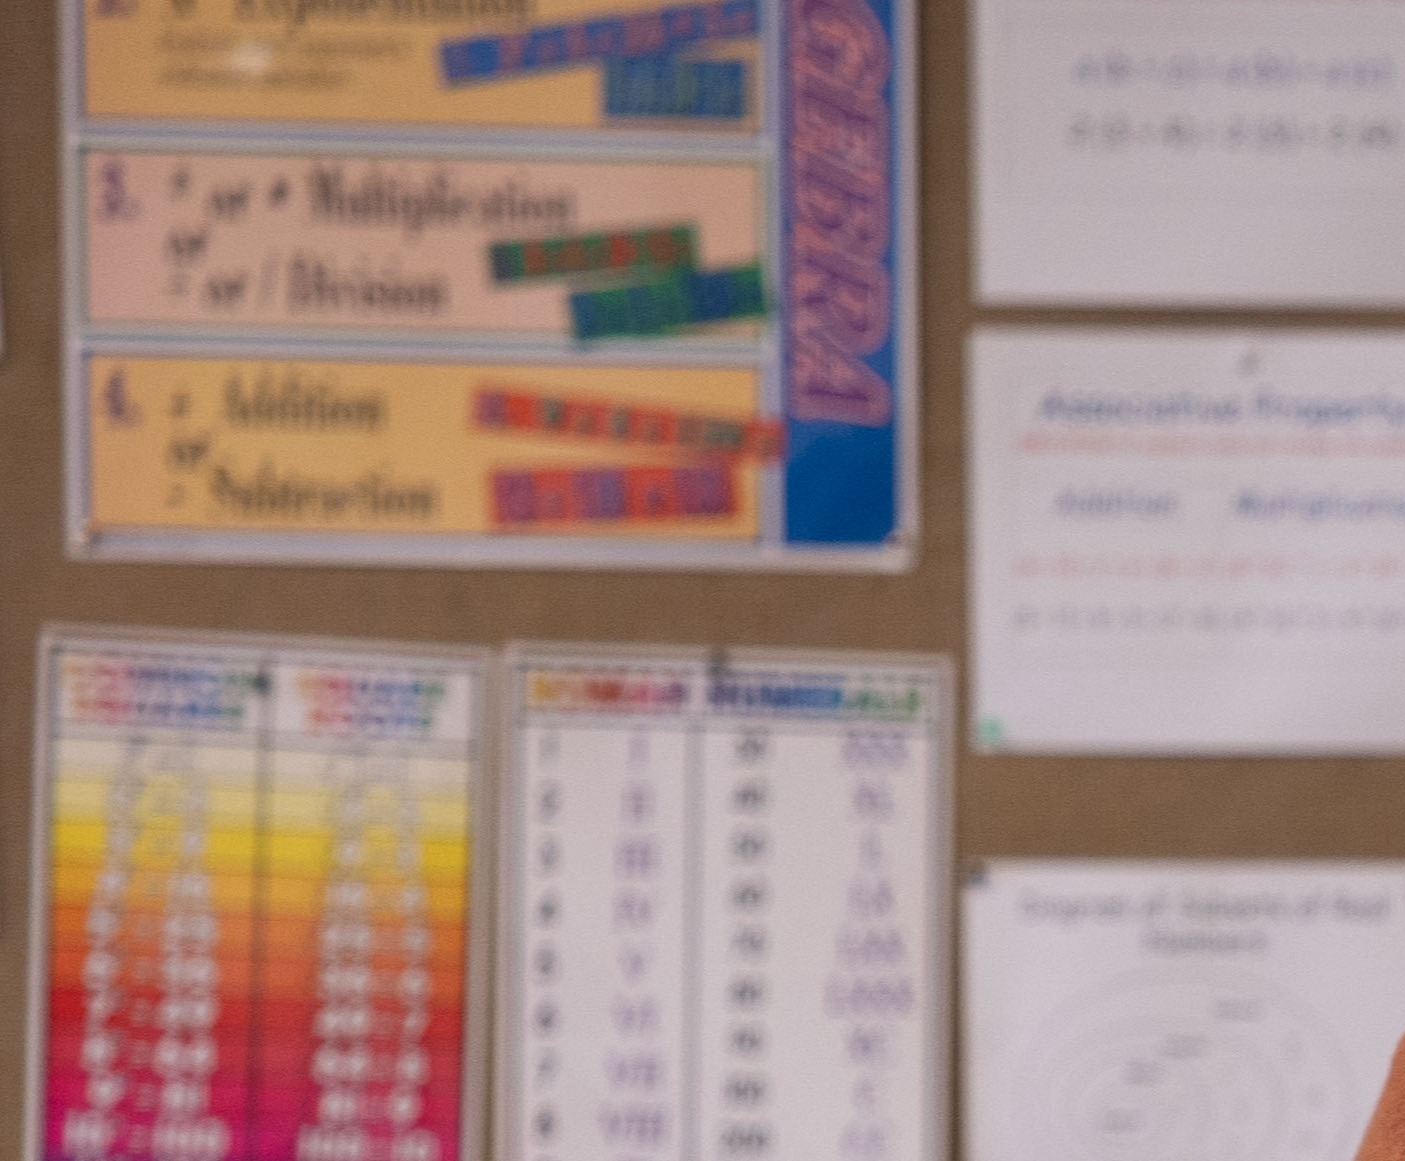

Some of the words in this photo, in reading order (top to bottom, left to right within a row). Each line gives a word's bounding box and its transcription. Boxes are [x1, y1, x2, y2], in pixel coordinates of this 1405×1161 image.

[307, 163, 577, 228] Multiplication
[287, 256, 452, 314] Division
[222, 369, 388, 430] Addition
[1036, 387, 1241, 422] Associative
[211, 463, 440, 519] Subtraction
[1054, 486, 1180, 518] Addition
